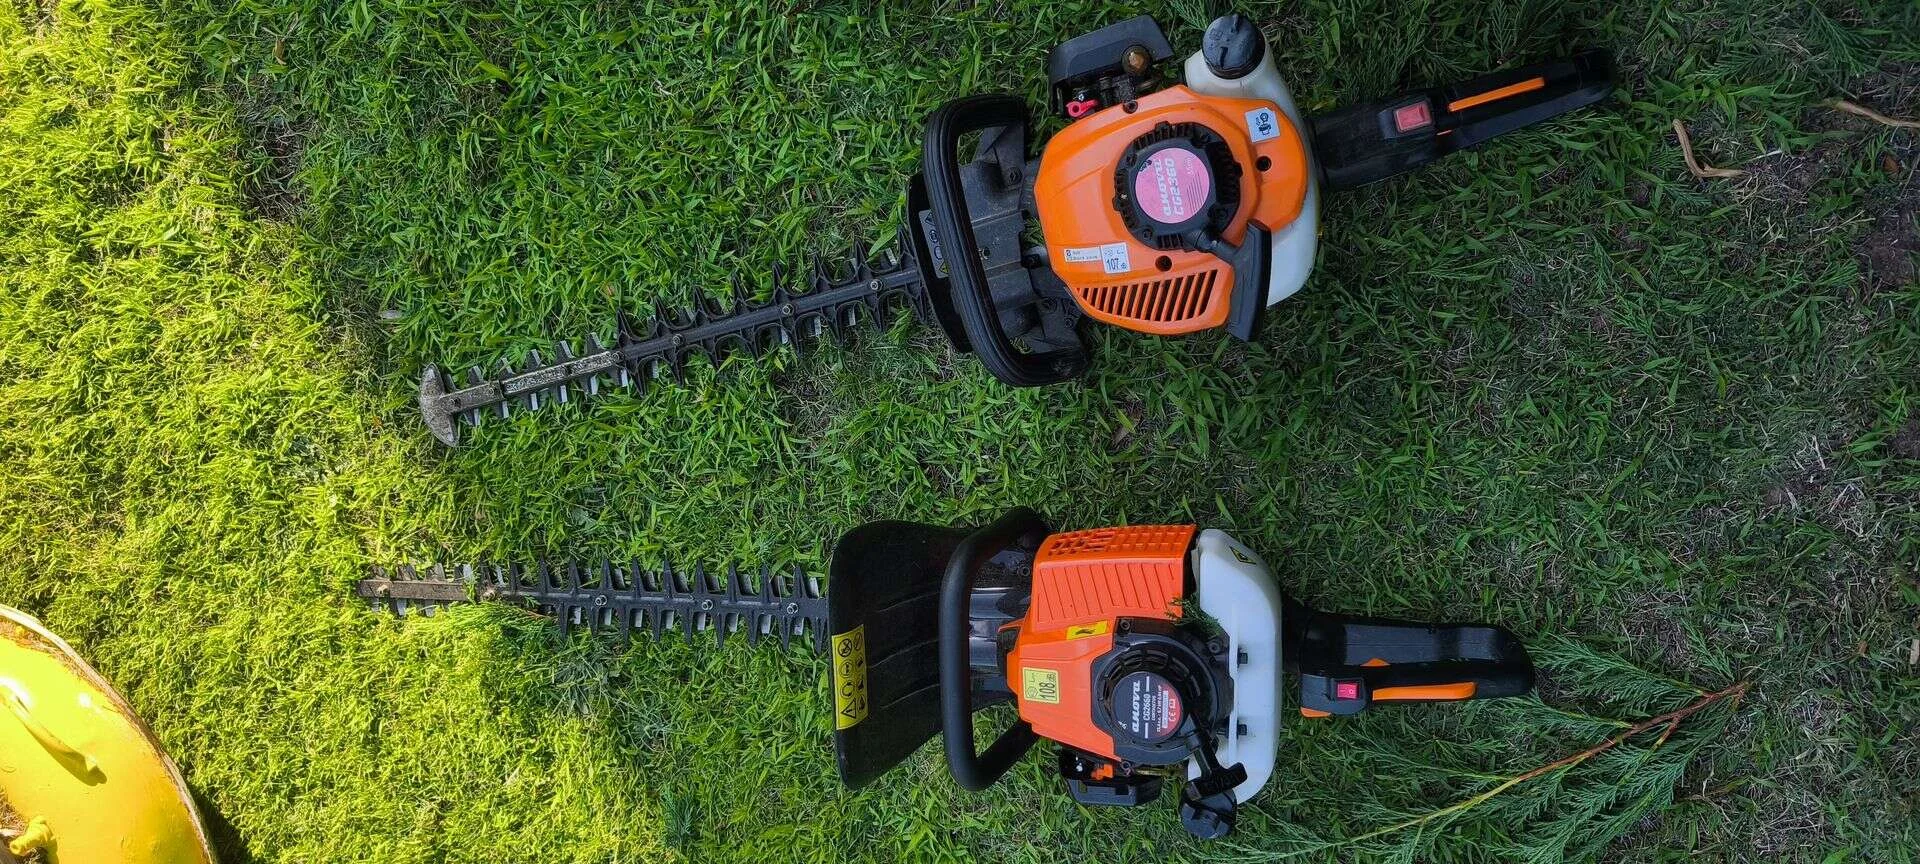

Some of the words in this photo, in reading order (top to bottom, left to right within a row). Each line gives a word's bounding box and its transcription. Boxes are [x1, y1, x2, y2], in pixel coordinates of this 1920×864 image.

[1165, 158, 1184, 216] CG2360
[1106, 257, 1119, 271] 107
[1038, 682, 1056, 699] 108
[1132, 680, 1140, 733] anova
[1143, 693, 1151, 721] CG2660
